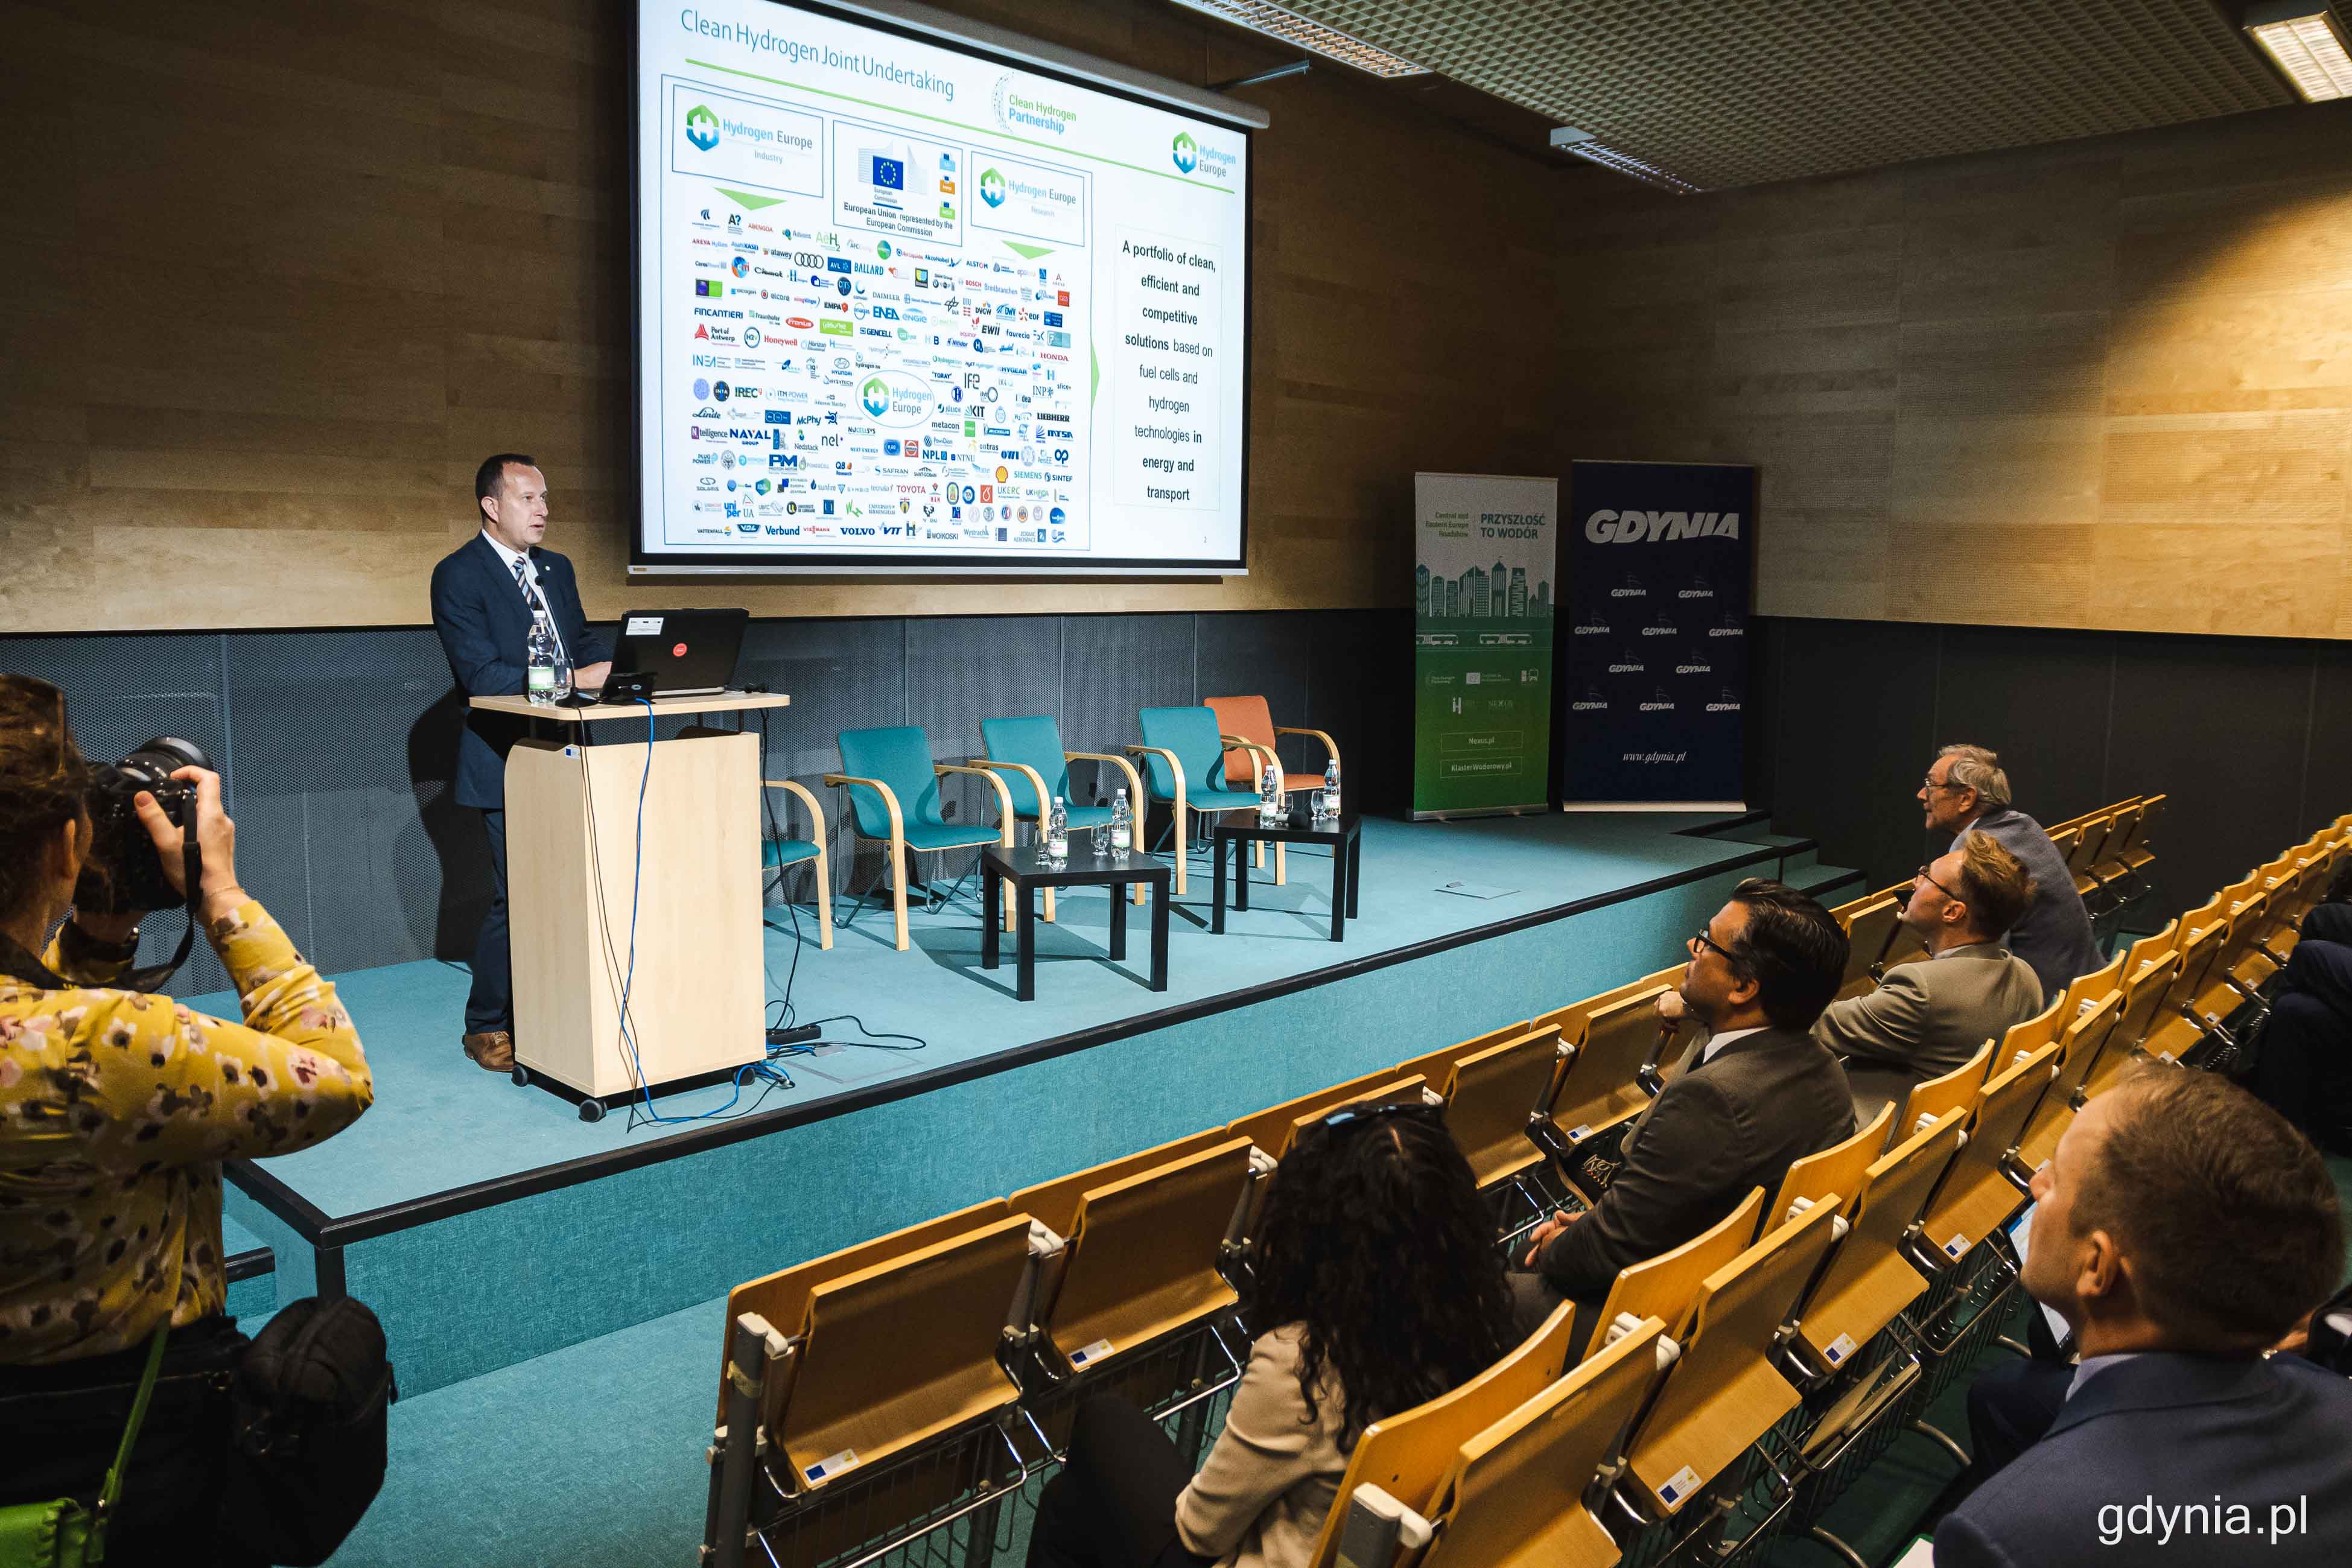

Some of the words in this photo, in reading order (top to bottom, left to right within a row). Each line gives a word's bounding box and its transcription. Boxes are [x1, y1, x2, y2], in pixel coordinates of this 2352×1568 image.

[681, 9, 731, 40] Clean
[737, 24, 819, 63] Hydrogen
[822, 46, 860, 72] Joint
[863, 54, 954, 101] Undertaking
[1009, 94, 1034, 110] Clean
[1036, 98, 1076, 121] Hydrogen
[1009, 109, 1064, 135] Partnership
[723, 118, 773, 141] Hydrogen
[777, 132, 813, 150] Europe
[754, 150, 783, 164] Industry
[1200, 144, 1236, 165] Hydrogen
[1200, 160, 1226, 177] Europe
[1008, 180, 1047, 198] Hydrogen
[1049, 188, 1076, 205] Europe
[845, 203, 876, 215] European
[878, 208, 896, 218] Union
[900, 214, 935, 226] represented
[936, 222, 942, 231] by
[748, 223, 773, 232] ABENGOA
[866, 217, 895, 230] European
[897, 223, 932, 236] Commission
[771, 249, 792, 259] atawey
[1122, 240, 1130, 253] A
[1134, 243, 1174, 262] portfolio
[1177, 252, 1187, 265] of
[1189, 255, 1216, 273] clean,
[854, 262, 883, 275] BALLARD
[967, 261, 988, 269] ALSTOM
[1141, 276, 1178, 294] efficient
[1183, 284, 1200, 296] and
[872, 291, 900, 301] DAIMLER
[694, 308, 743, 319] FINCANTIERI
[975, 306, 991, 315] DVGW
[1143, 306, 1198, 325] competitive
[755, 313, 780, 321] Fraunhofer
[711, 334, 735, 342] Antwerp
[866, 329, 892, 338] GENCELL
[1006, 329, 1030, 339] faurecia
[764, 335, 797, 346] Honeywell
[1125, 334, 1169, 351] solutions
[1174, 338, 1200, 357] based
[1203, 346, 1213, 358] on
[1040, 352, 1068, 361] HONDA
[1140, 364, 1156, 379] fuel
[1160, 368, 1180, 382] cells
[1183, 372, 1198, 384] and
[735, 387, 758, 398] IREC
[892, 387, 932, 401] Hydrogen
[892, 401, 921, 415] Europe
[971, 405, 985, 417] KIT
[1149, 396, 1189, 414] hydrogen
[693, 407, 720, 419] Linde
[1037, 413, 1070, 422] LIEBHERR
[796, 416, 821, 425] McPhy
[729, 428, 771, 440] NAVAL
[822, 434, 839, 446] nel
[1135, 425, 1190, 443] technologies
[1194, 430, 1202, 443] in
[769, 454, 797, 467] PM
[923, 450, 940, 460] NPL
[957, 454, 974, 462] NTNU
[1143, 456, 1174, 472] energy
[1177, 459, 1194, 472] and
[897, 485, 926, 494] TOYOTA
[1148, 485, 1190, 503] transport
[1481, 513, 1545, 525] PRZYSZŁOŚĆ
[765, 525, 799, 535] Verbund
[883, 527, 902, 535] VTT
[1585, 509, 1739, 543] GDYNIA
[1481, 528, 1494, 538] TO
[1498, 527, 1538, 539] WODÓR
[1623, 752, 1686, 763] www.gdynia.pl
[1451, 763, 1512, 772] KlasterWodorowy.pl
